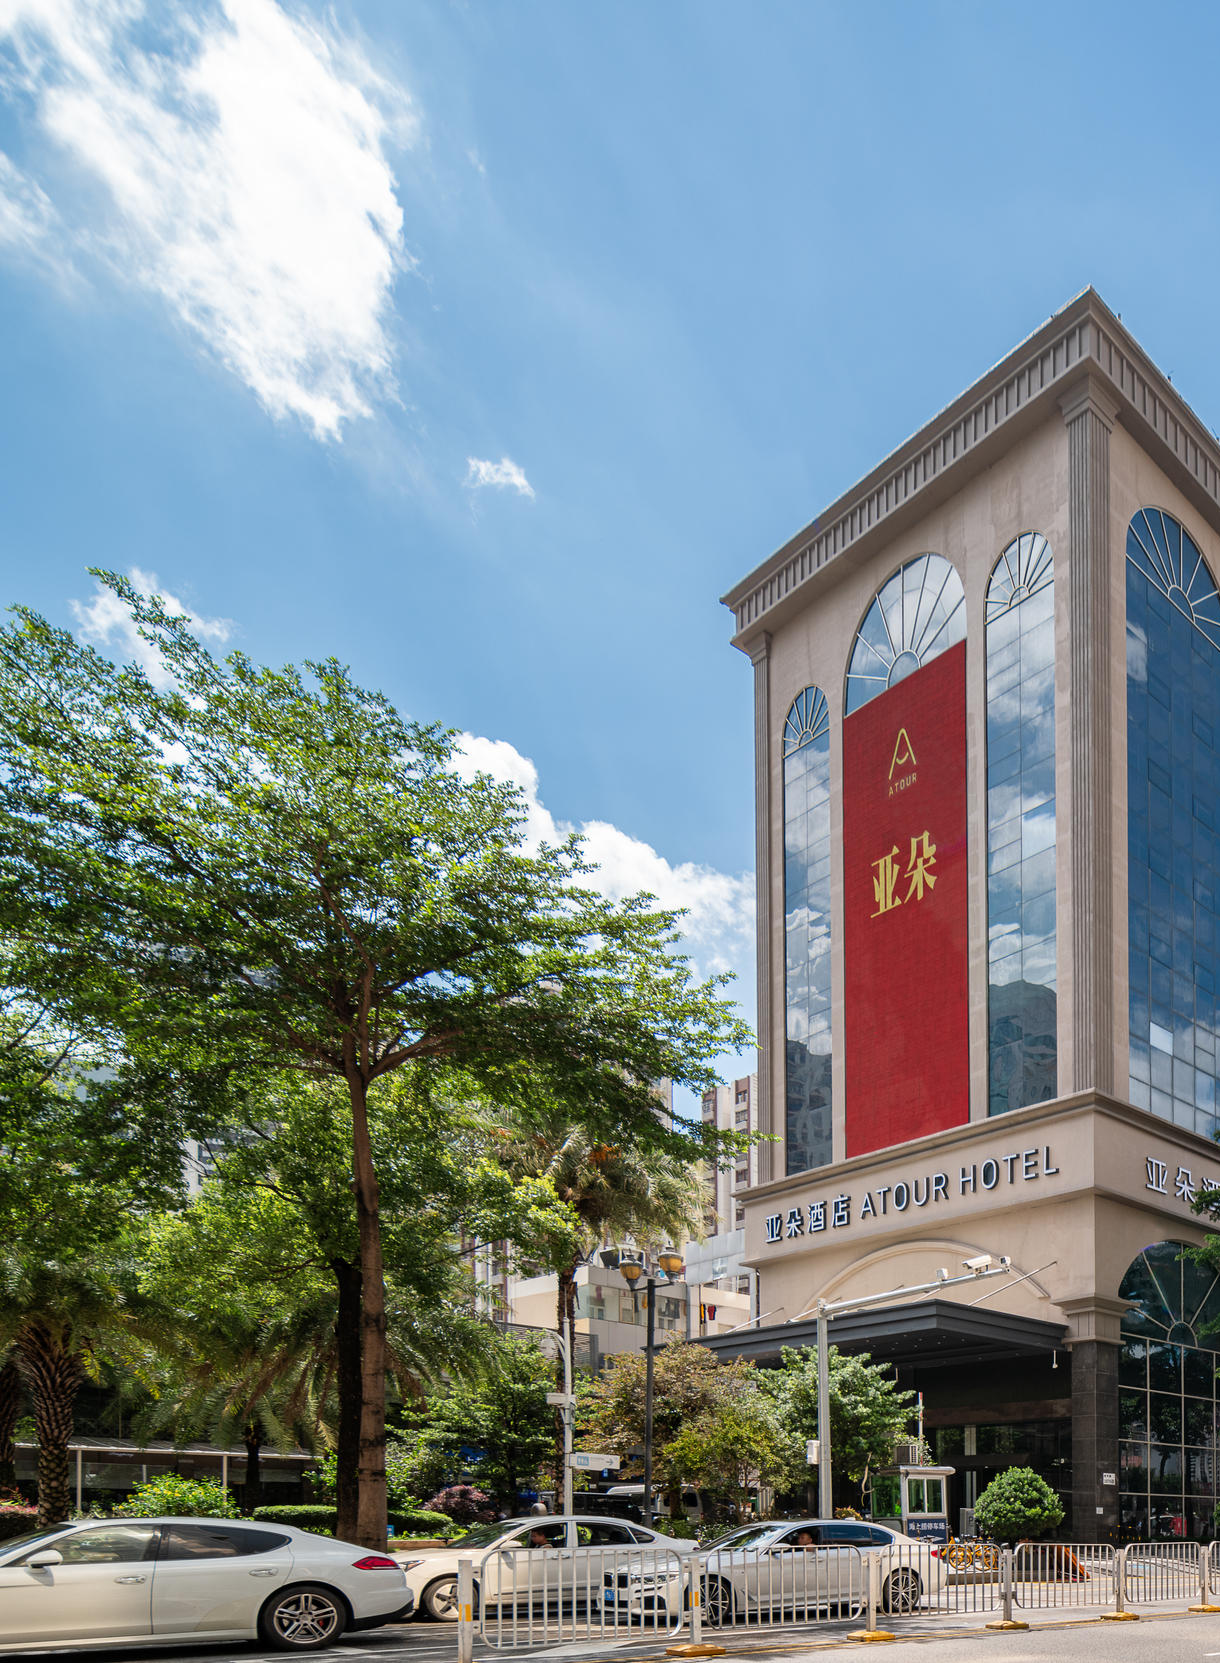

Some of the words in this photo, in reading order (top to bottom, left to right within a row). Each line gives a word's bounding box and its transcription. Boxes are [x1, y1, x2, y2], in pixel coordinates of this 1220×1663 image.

[888, 772, 917, 797] ATOUR
[870, 830, 937, 918] 亚朵
[764, 1195, 851, 1243] 亚朵酒店
[860, 1172, 949, 1219] ATOUR
[958, 1145, 1059, 1195] HOTEL
